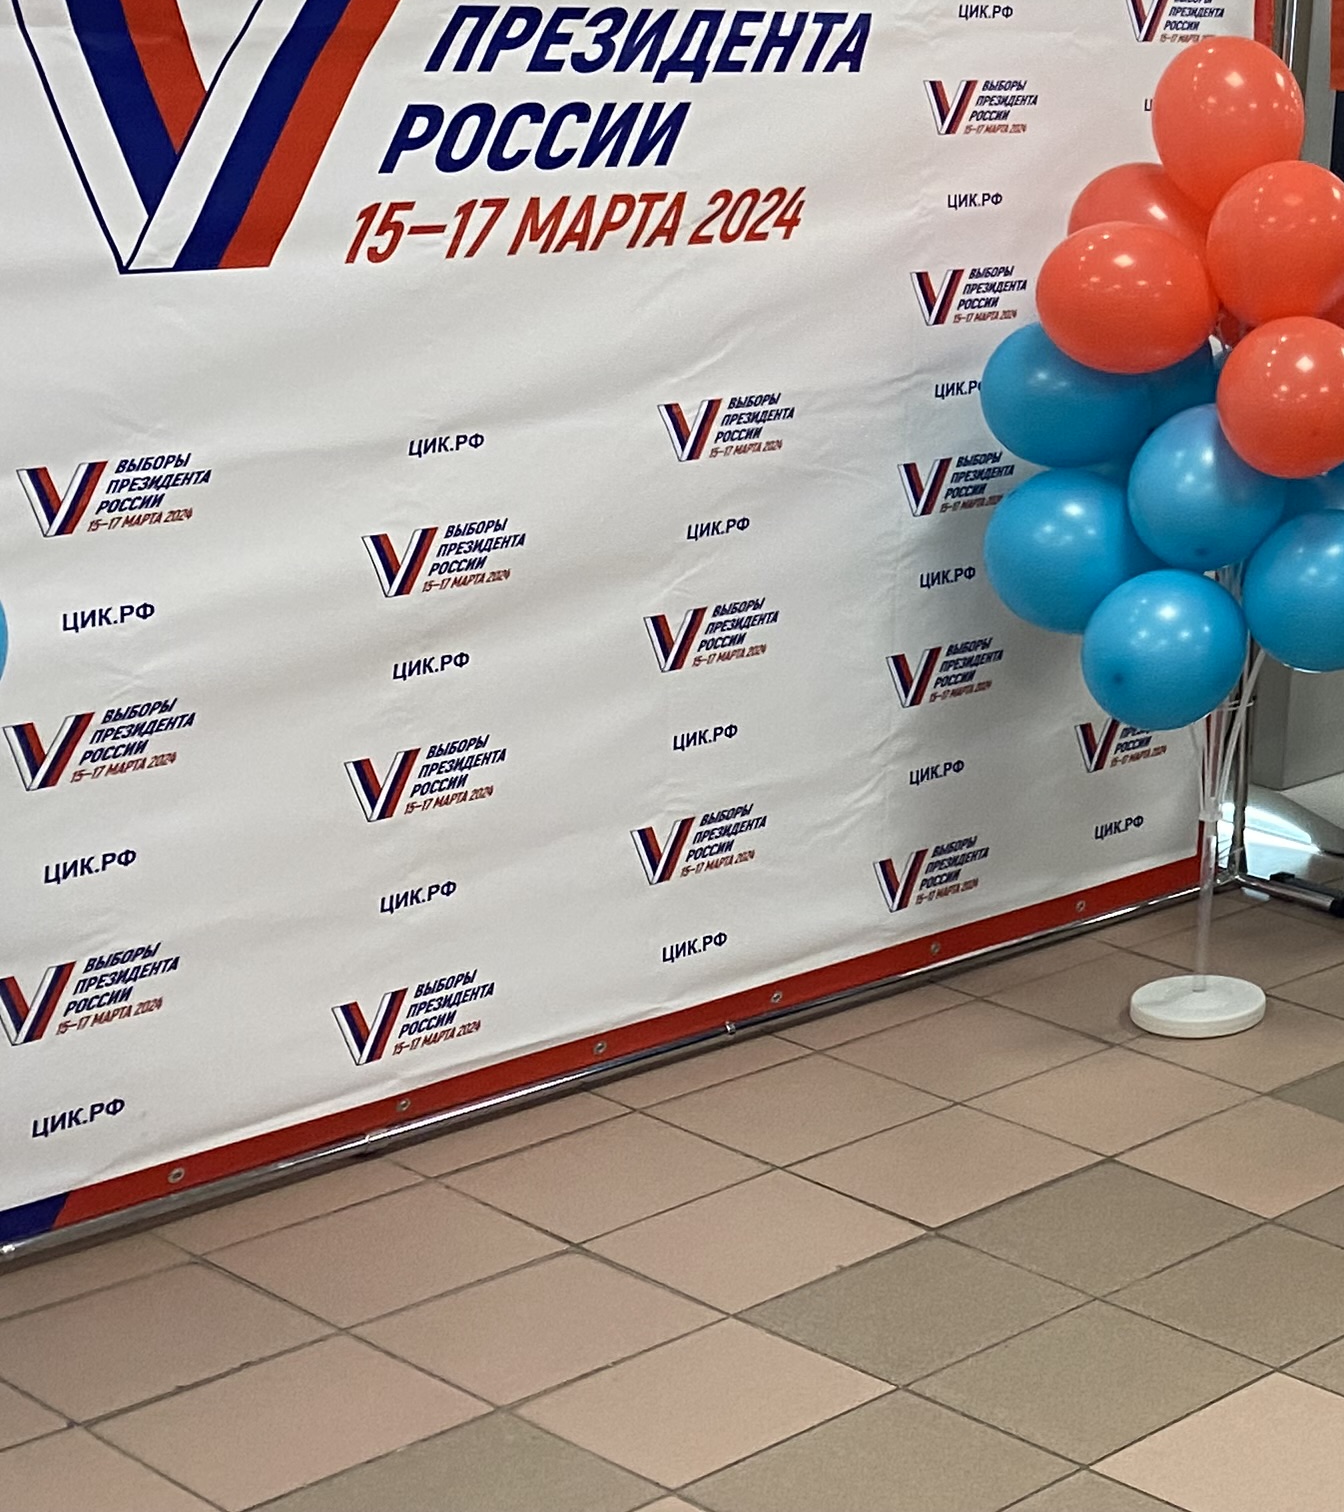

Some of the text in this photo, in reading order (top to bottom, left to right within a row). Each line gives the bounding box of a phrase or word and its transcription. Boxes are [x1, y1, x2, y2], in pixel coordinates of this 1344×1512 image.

[958, 4, 1013, 19] ЦИК.РФ
[1168, 6, 1224, 18] ПРЕЗИДЕНТА
[1164, 20, 1199, 31] РОССИИ
[424, 4, 872, 84] ПРЕЗИДЕНТА
[982, 80, 1027, 91] ВЫБОРЫ
[975, 94, 1038, 107] ПРЕЗИДЕНТА
[968, 110, 1010, 122] РОССИИ
[378, 101, 692, 174] РОССИИ
[947, 193, 1003, 209] ЦИК.РФ
[507, 191, 688, 256] МАРТА
[687, 185, 807, 246] 2024
[968, 265, 1014, 279] ВЫБОРЫ
[963, 279, 1027, 295] ПРЕЗИДЕНТА
[957, 297, 1000, 310] РОССИИ
[727, 392, 782, 410] ВЫБОРЫ
[720, 406, 795, 427] ПРЕЗИДЕНТА
[408, 433, 485, 458] ЦИК.РФ
[714, 426, 763, 444] РОССИИ
[115, 452, 191, 474] ВЫБОРЫ
[956, 452, 1002, 468] ВЫБОРЫ
[106, 469, 212, 495] ПРЕЗИДЕНТА
[950, 464, 1014, 484] ПРЕЗИДЕНТА
[95, 493, 165, 515] РОССИИ
[944, 483, 986, 500] РОССИИ
[122, 511, 161, 529] МАРТА
[163, 507, 193, 524] 2024
[444, 517, 509, 539] ВЫБОРЫ
[686, 516, 751, 541] ЦИК.РФ
[435, 532, 527, 558] ПРЕЗИДЕНТА
[427, 555, 487, 577] РОССИИ
[919, 567, 976, 589] ЦИК.РФ
[62, 603, 156, 633] ЦИК.РФ
[711, 597, 766, 618] ВЫБОРЫ
[704, 610, 780, 636] ПРЕЗИДЕНТА
[697, 632, 746, 653] РОССИИ
[392, 652, 470, 681] ЦИК.РФ
[101, 697, 178, 724] ВЫБОРЫ
[90, 712, 196, 744] ПРЕЗИДЕНТА
[672, 724, 738, 751] ЦИК.РФ
[79, 740, 149, 765] РОССИИ
[426, 734, 490, 759] ВЫБОРЫ
[105, 758, 146, 777] МАРТА
[148, 751, 177, 769] 2024
[418, 748, 507, 778] ПРЕЗИДЕНТА
[909, 760, 965, 786] ЦИК.РФ
[410, 773, 468, 798] РОССИИ
[700, 804, 754, 826] ВЫБОРЫ
[693, 815, 767, 844] ПРЕЗИДЕНТА
[1094, 816, 1144, 841] ЦИК.РФ
[685, 839, 734, 862] РОССИИ
[931, 836, 978, 858] ВЫБОРЫ
[43, 849, 137, 885] ЦИК.РФ
[924, 847, 989, 874] ПРЕЗИДЕНТА
[919, 869, 961, 890] РОССИИ
[380, 880, 457, 914] ЦИК.РФ
[82, 942, 162, 974] ВЫБОРЫ
[661, 932, 728, 963] ЦИК.РФ
[73, 956, 180, 996] ПРЕЗИДЕНТА
[413, 969, 478, 999] ВЫБОРЫ
[62, 987, 133, 1018] РОССИИ
[91, 1005, 132, 1027] МАРТА
[134, 996, 163, 1018] 2024
[406, 982, 495, 1019] ПРЕЗИДЕНТА
[398, 1010, 457, 1039] РОССИИ
[32, 1099, 126, 1139] ЦИК.РФ
